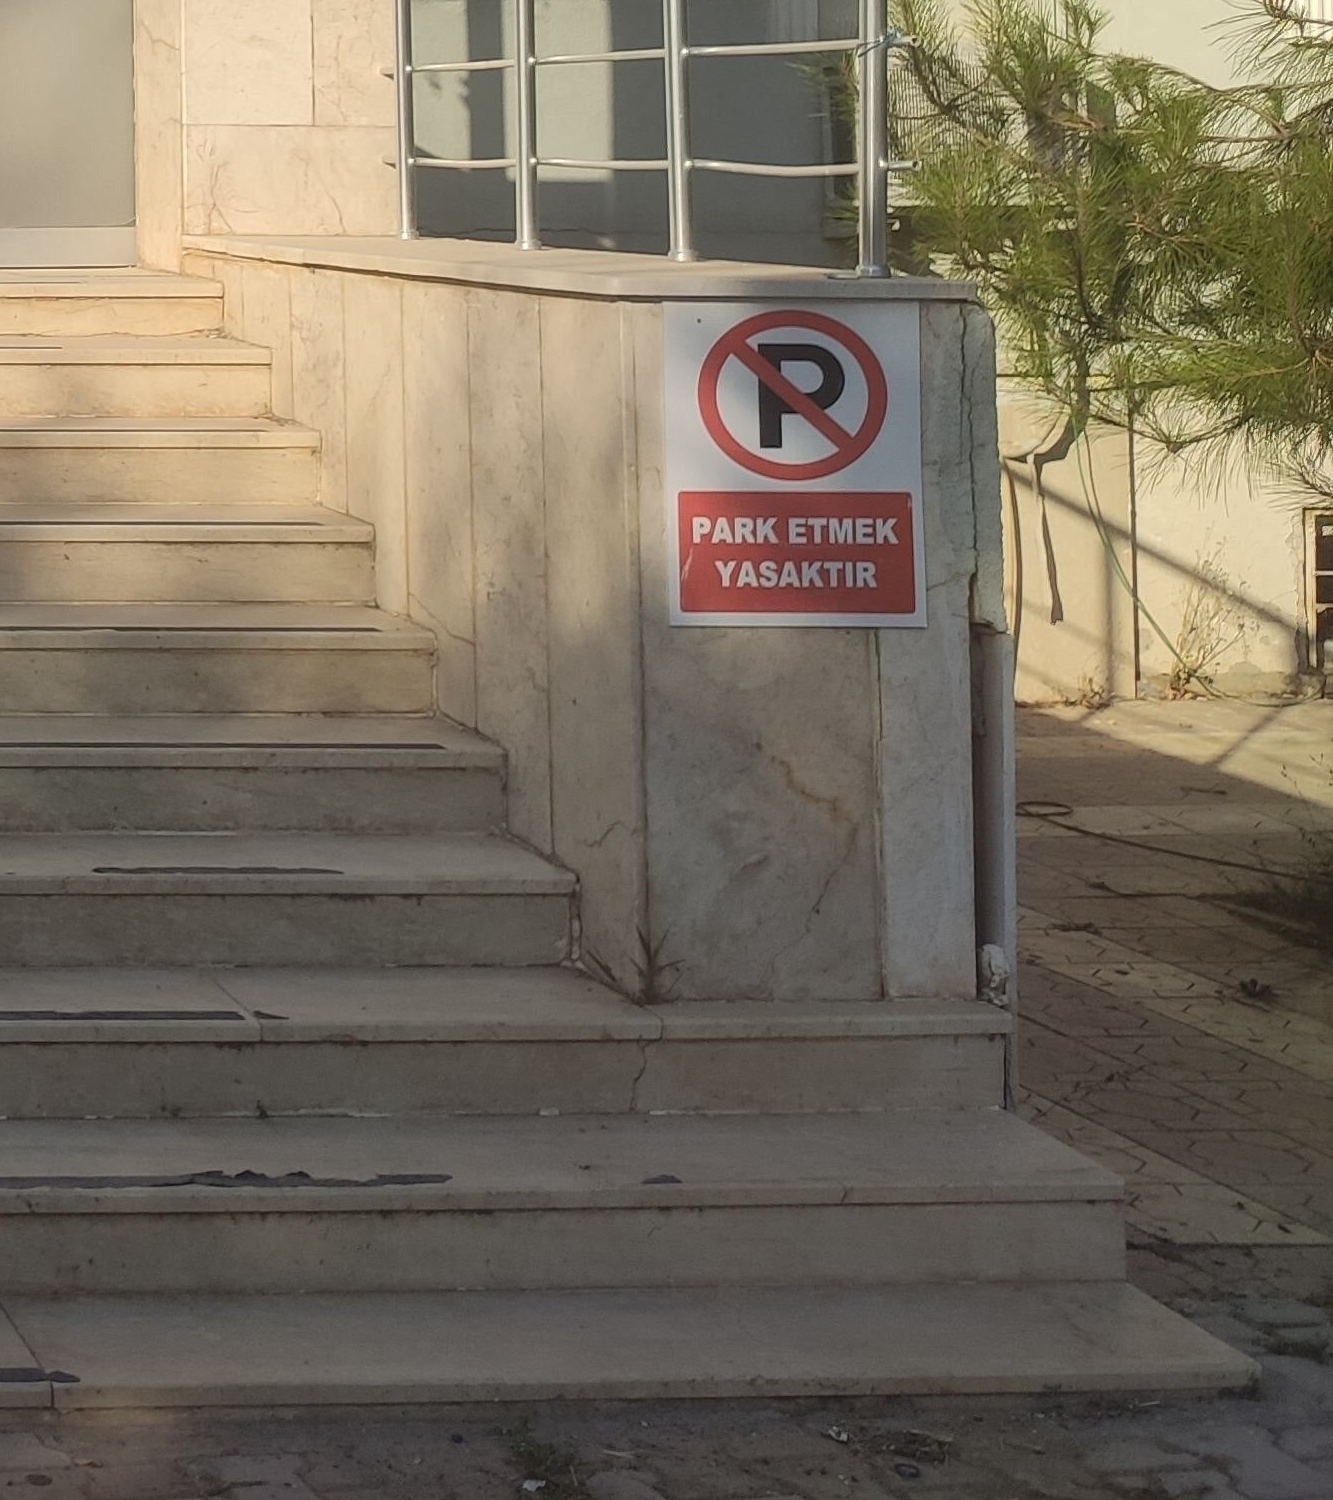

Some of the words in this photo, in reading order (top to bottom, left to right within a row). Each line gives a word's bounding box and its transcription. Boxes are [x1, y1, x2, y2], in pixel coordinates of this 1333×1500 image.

[691, 516, 778, 545] PARK
[788, 517, 899, 545] ETMEK
[715, 560, 878, 589] YASAKTIR
